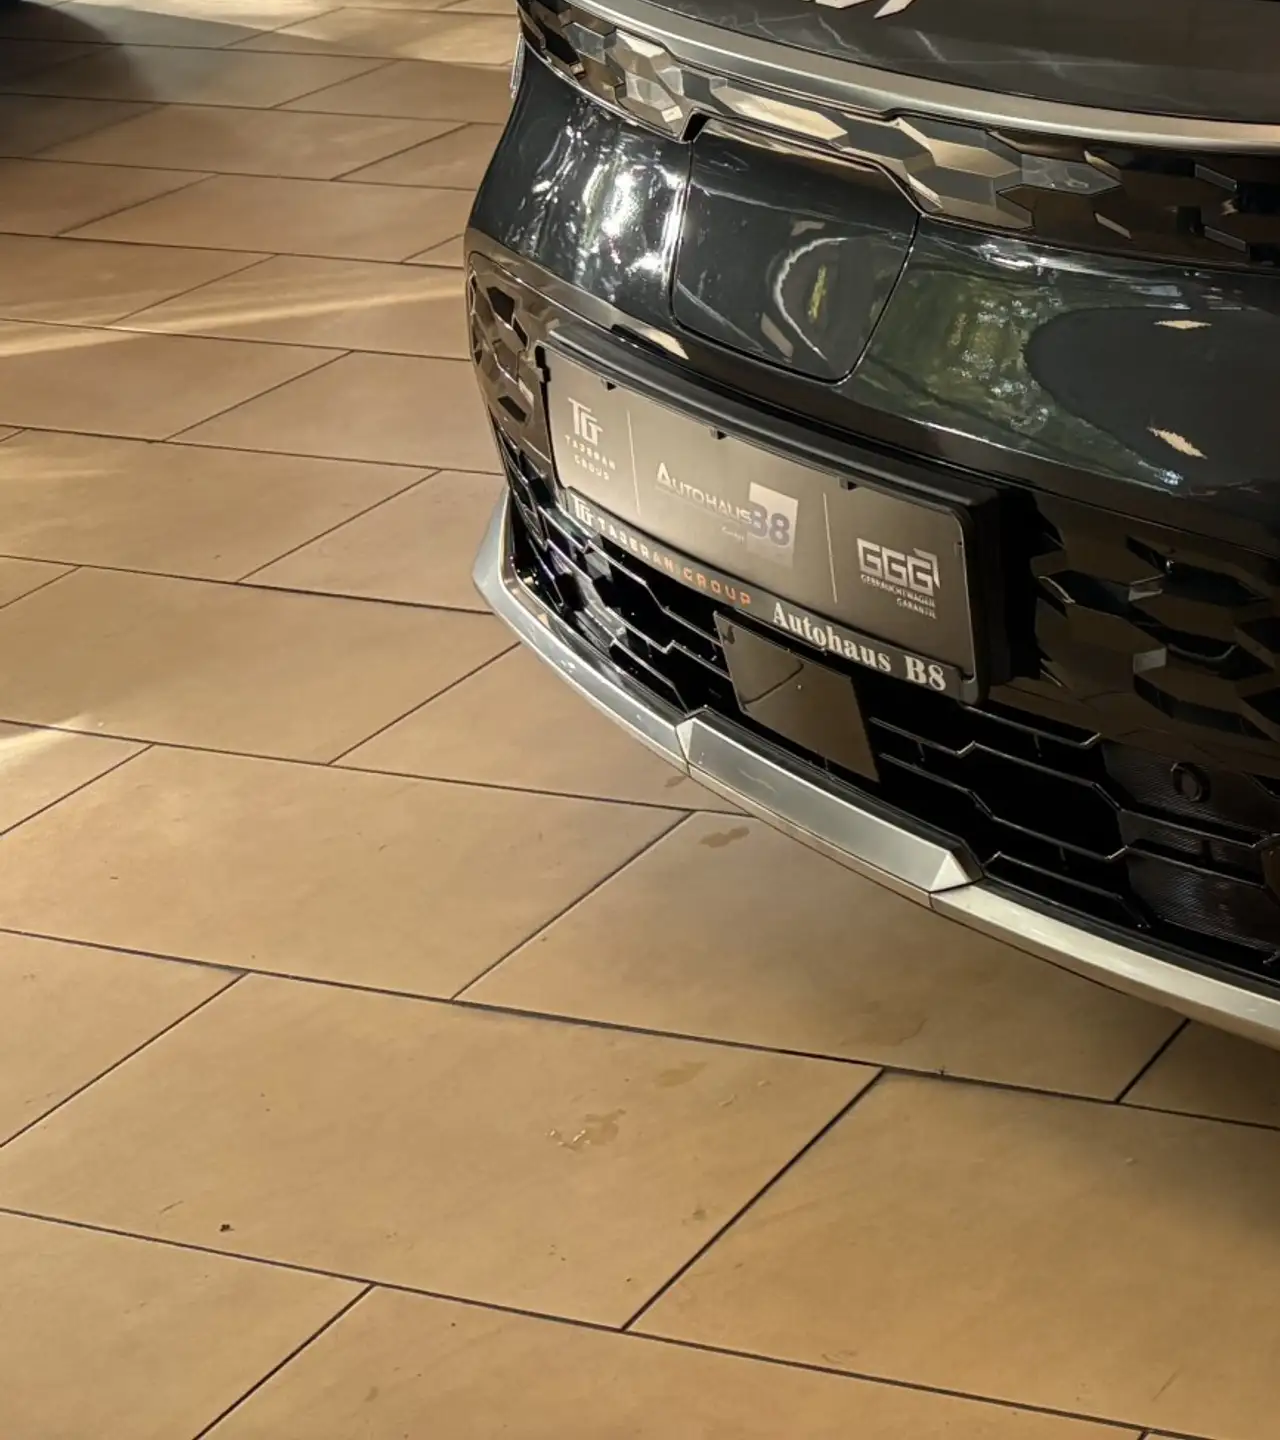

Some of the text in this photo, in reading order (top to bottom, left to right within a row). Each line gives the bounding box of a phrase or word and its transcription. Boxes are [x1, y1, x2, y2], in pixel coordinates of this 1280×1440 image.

[683, 566, 752, 606] GROUP
[772, 601, 947, 692] Autohaus B8
